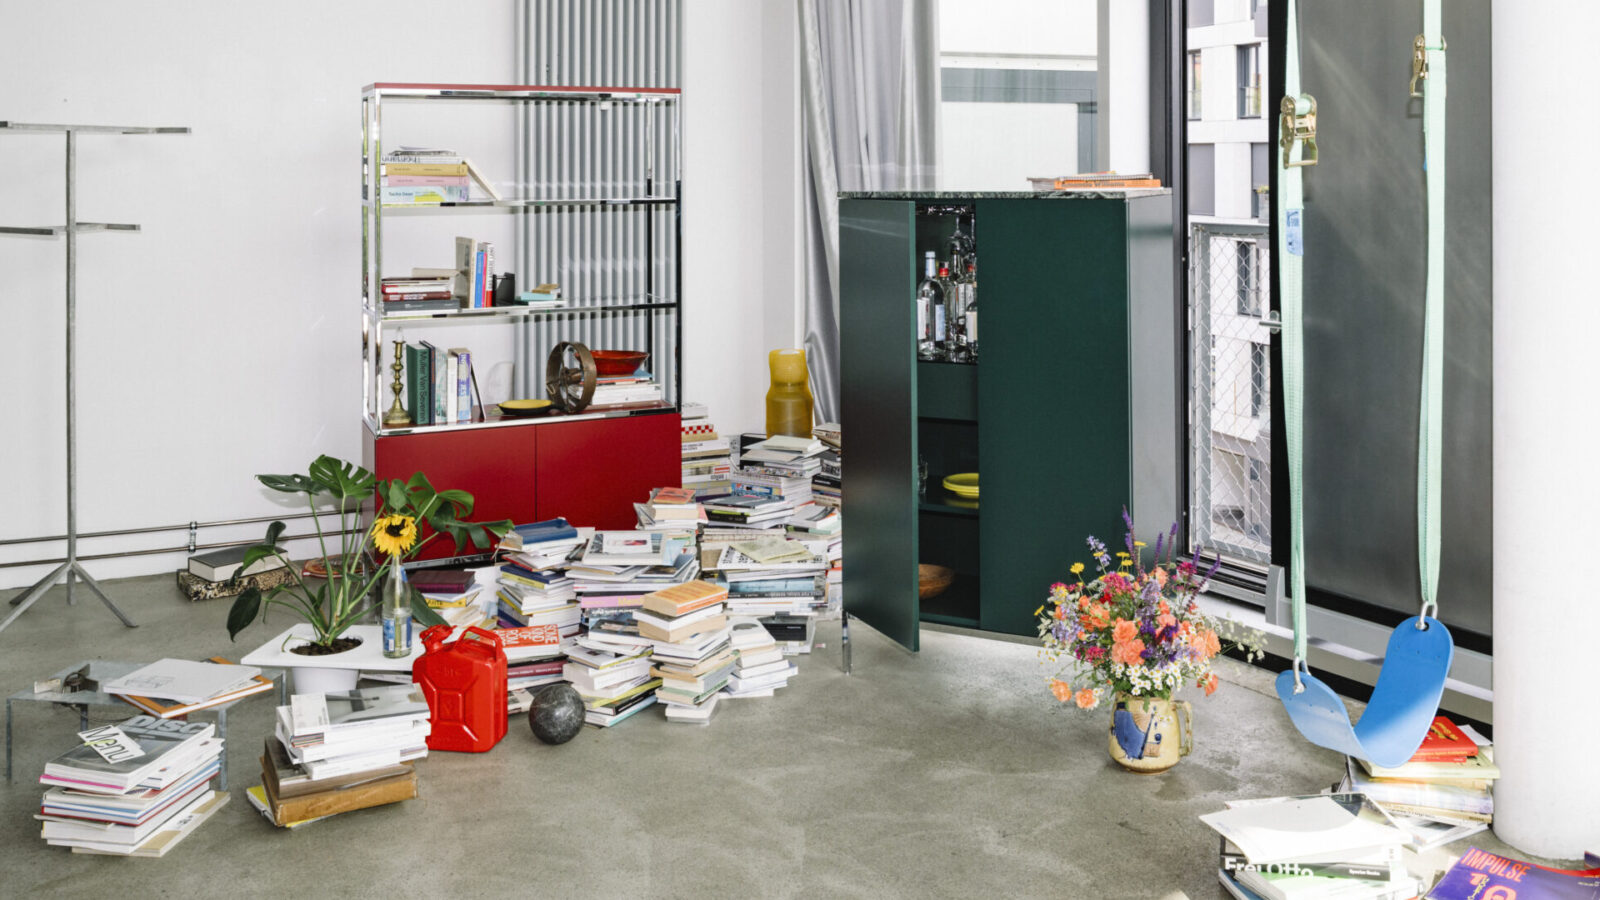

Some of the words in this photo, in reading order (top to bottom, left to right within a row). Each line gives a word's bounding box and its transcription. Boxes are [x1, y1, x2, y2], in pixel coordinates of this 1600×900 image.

[419, 375, 428, 390] Van
[419, 391, 428, 422] Severen
[544, 624, 558, 644] SOME
[81, 725, 134, 761] Menu
[1461, 848, 1531, 882] IMPULSE
